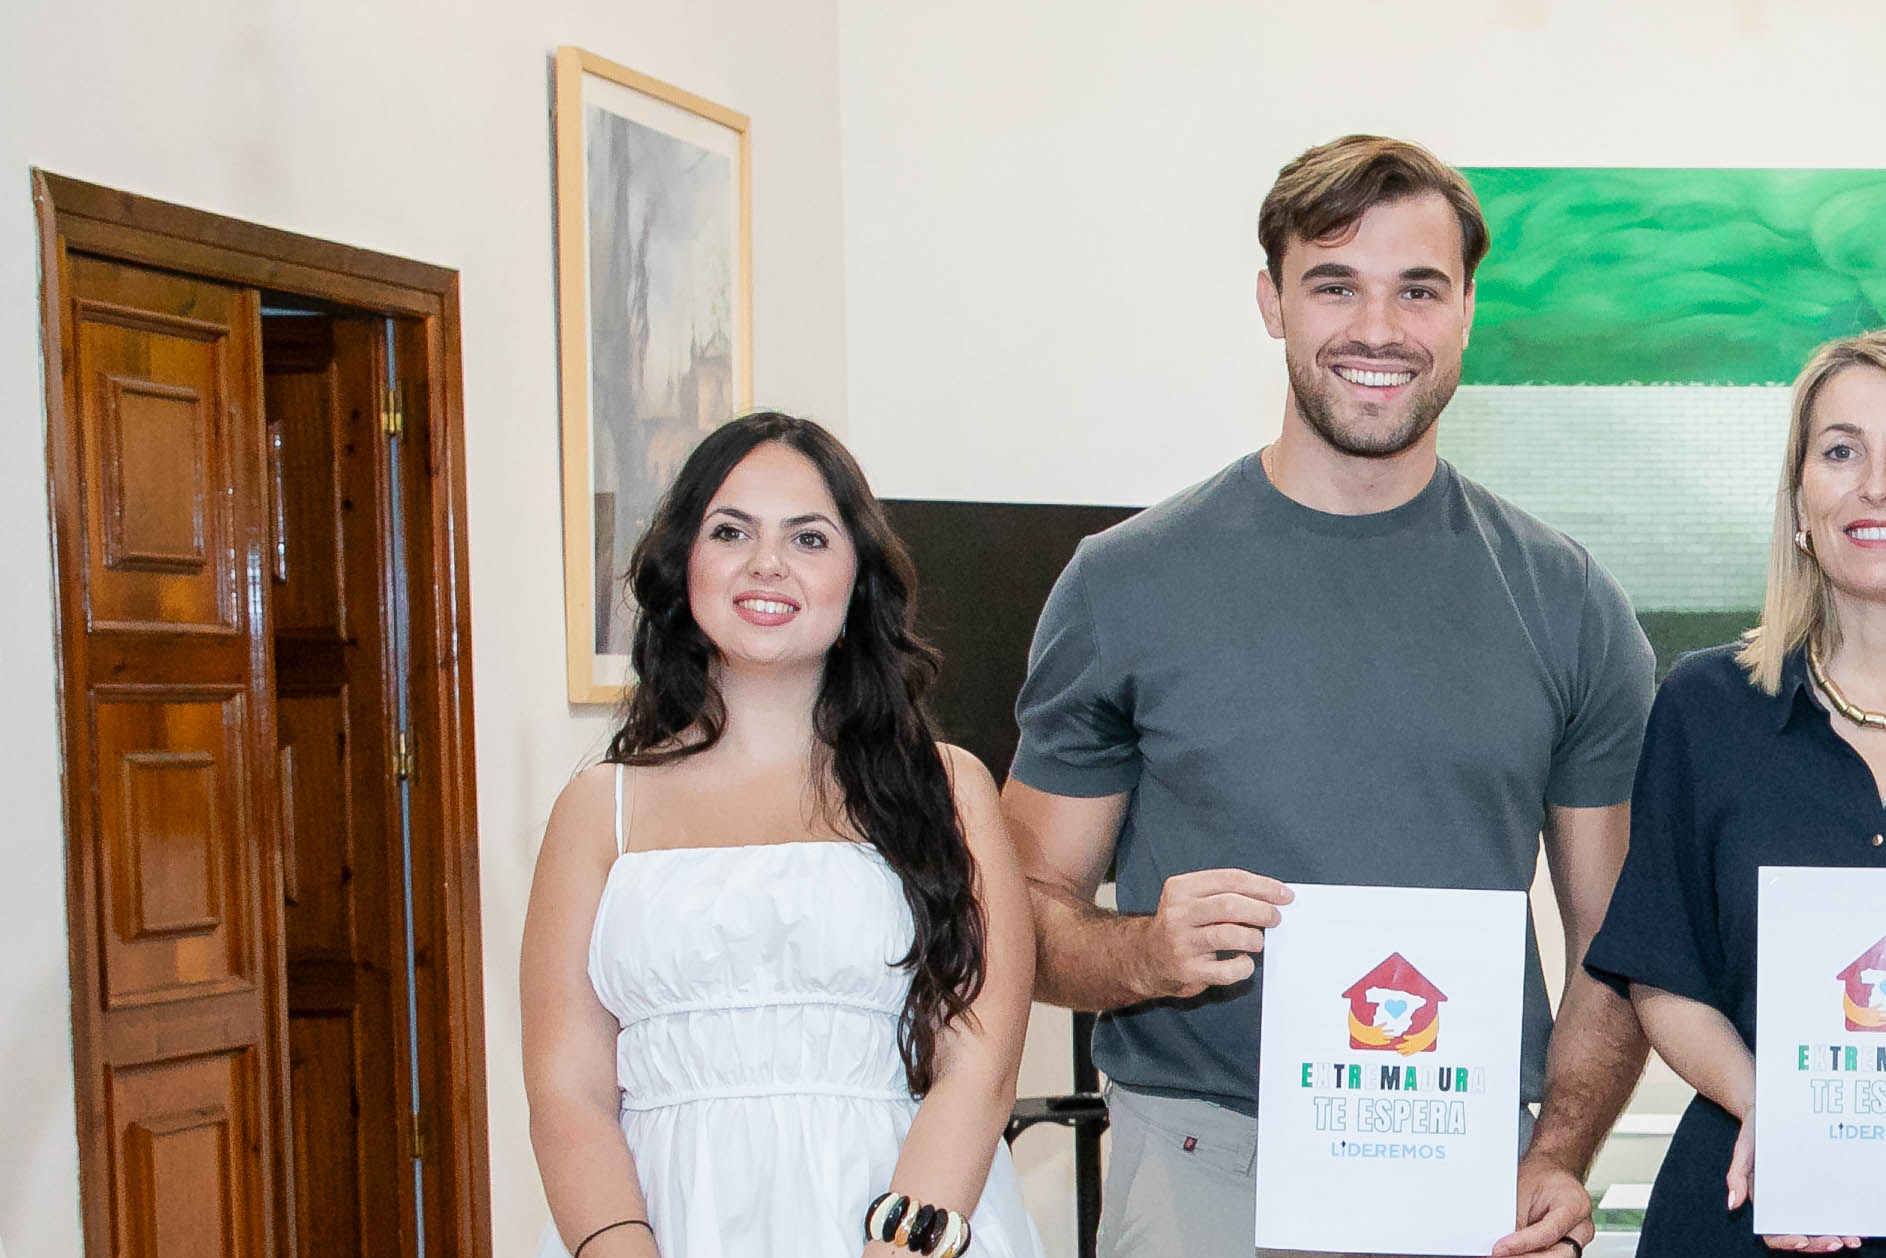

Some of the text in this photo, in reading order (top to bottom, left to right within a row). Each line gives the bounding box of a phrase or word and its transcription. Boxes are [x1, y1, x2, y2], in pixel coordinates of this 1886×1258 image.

[1810, 1079, 1844, 1114] TE
[1313, 1096, 1466, 1134] TE ESPERA
